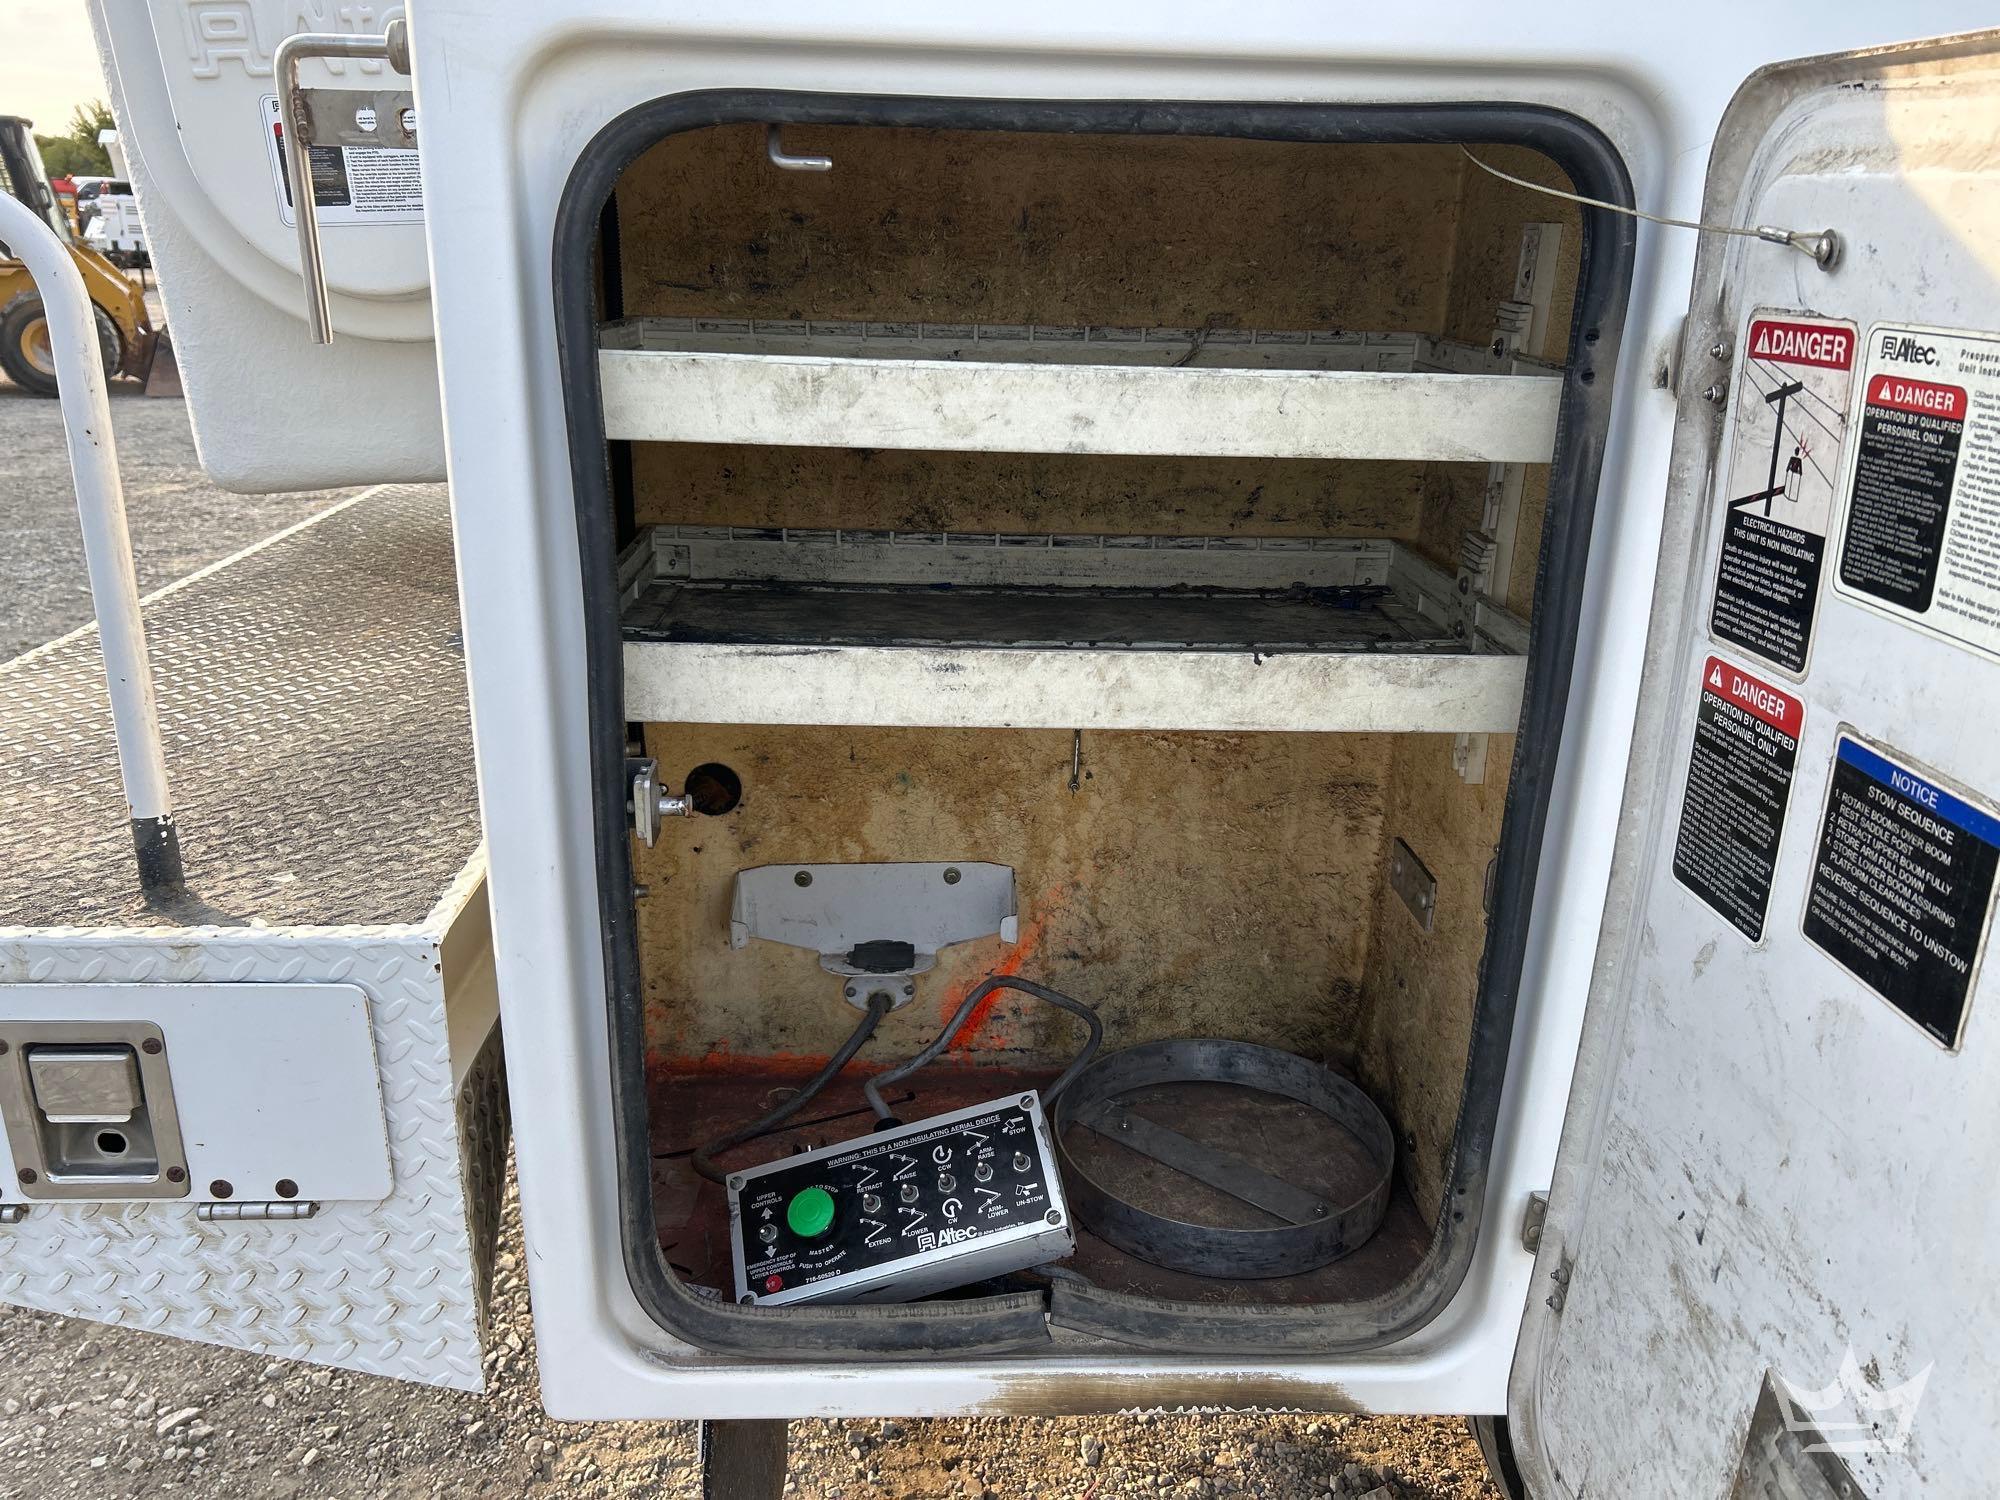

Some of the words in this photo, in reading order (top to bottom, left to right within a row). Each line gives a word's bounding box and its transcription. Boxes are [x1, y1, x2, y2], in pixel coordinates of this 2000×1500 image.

[1771, 331, 1848, 363] DANGER
[1896, 337, 1936, 365] Altec
[1894, 384, 1955, 411] DANGER
[1865, 406, 1905, 424] OPERATION
[1908, 414, 1919, 425] BY
[1920, 416, 1963, 434] QUALIFIED
[1877, 422, 1921, 441] PERSONNEL
[1922, 431, 1945, 445] ONLY
[1743, 516, 1775, 535] ELECTRICAL
[1777, 527, 1805, 544] HAZARDS
[1734, 527, 1746, 539] THIS
[1747, 532, 1759, 543] UNIT
[1760, 536, 1766, 546] IS
[1767, 539, 1780, 550] NON
[1780, 543, 1815, 562] INSULATING
[1732, 676, 1785, 720] DANGER
[1703, 691, 1743, 721] OPERATION
[1743, 713, 1754, 727] BY
[1755, 720, 1795, 751] QUALIFIED
[1713, 712, 1755, 746] PERSONNEL
[1757, 738, 1777, 757] ONLY
[1891, 770, 1939, 809] NOTICE
[1835, 788, 1840, 799] 1.
[1841, 792, 1870, 817] ROTATE
[1871, 809, 1900, 834] BOOMS
[1900, 828, 1924, 850] OVER
[1924, 842, 1951, 866] BOOM
[1868, 785, 1897, 810] STOW
[1897, 803, 1954, 845] SEQUENCE
[1839, 804, 1860, 822] REST
[1860, 816, 1890, 843] SADDLE
[1891, 835, 1913, 856] POST
[1828, 823, 1833, 834] 3.
[1835, 828, 1860, 851] STORE
[1860, 845, 1878, 862] ARM
[1878, 856, 1896, 876] FULL
[1898, 869, 1925, 893] DOWN
[1830, 812, 1836, 822] 2.
[1837, 816, 1871, 844] RETRACT
[1872, 838, 1899, 862] UPPER
[1899, 855, 1925, 878] BOOM
[1925, 872, 1952, 895] FULLY
[1825, 836, 1831, 846] 4.
[1833, 840, 1858, 863] STORE
[1858, 856, 1886, 882] LOWER
[1886, 875, 1911, 898] BOOM
[1911, 893, 1955, 928] ASSURING
[1830, 851, 1868, 884] PLATFORM
[1869, 878, 1921, 920] CLEARANCES
[1813, 894, 1834, 913] RESULT
[1834, 909, 1841, 918] IN
[1841, 914, 1865, 937] DAMAGE
[1866, 932, 1874, 943] TO
[1816, 882, 1838, 904] FAILURE
[1839, 898, 1847, 909] TO
[1847, 905, 1871, 927] FOLLOW
[1872, 922, 1904, 952] SEQUENCE
[1905, 946, 1919, 961] MAY
[1819, 862, 1857, 897] REVERSE
[1859, 890, 1908, 932] SEQUENCE
[1910, 924, 1922, 942] TO
[1923, 935, 1968, 974] UNSTOW
[1811, 905, 1820, 916] OR
[1820, 912, 1839, 930] HOSES
[1839, 927, 1847, 936] AT
[1847, 932, 1878, 959] PLATFORM
[827, 1153, 861, 1166] WARNING:
[862, 1147, 878, 1156] THIS
[894, 1128, 949, 1148] NON-INSULATING
[951, 1122, 974, 1132] AERIAL
[975, 1114, 1000, 1125] DEVICE
[1009, 1127, 1026, 1135] STOW
[978, 1151, 995, 1160] RAISE
[979, 1146, 994, 1154] ARM-
[899, 1171, 917, 1180] RAISE
[937, 1163, 951, 1171] CCW
[756, 1192, 776, 1201] UPPER
[824, 1184, 839, 1193] STOP
[857, 1182, 883, 1193] RETRACT
[1016, 1194, 1043, 1206] UN-STOW
[751, 1196, 782, 1209] CONTROLS
[987, 1209, 1009, 1219] LOWER
[988, 1205, 1003, 1213] ARM-
[868, 1237, 891, 1248] EXTEND
[907, 1227, 928, 1237] LOWER
[938, 1226, 977, 1247] Altec
[809, 1244, 834, 1255] MASTER
[824, 1250, 846, 1265] OPERATE
[747, 1258, 776, 1270] EMERGENCY
[750, 1267, 766, 1275] UPPER
[752, 1271, 769, 1279] LOWER
[769, 1264, 795, 1275] CONTROLS
